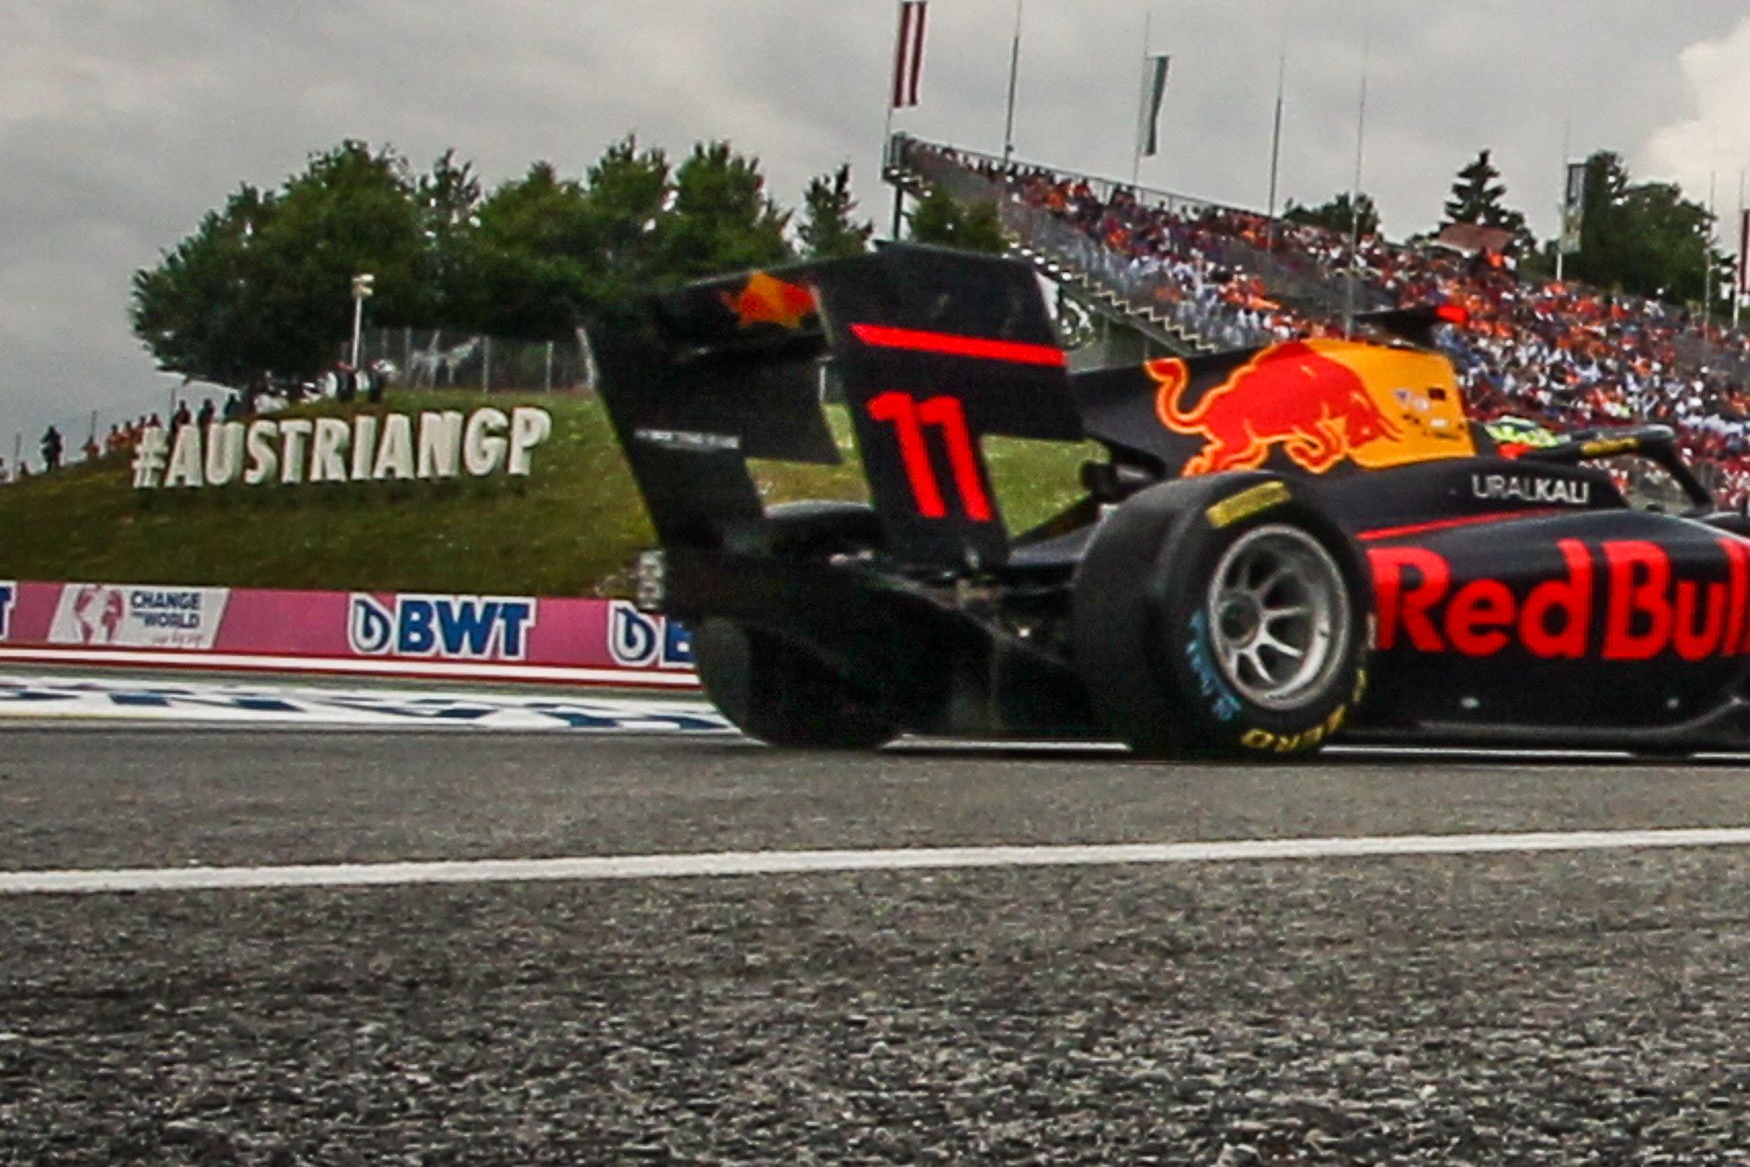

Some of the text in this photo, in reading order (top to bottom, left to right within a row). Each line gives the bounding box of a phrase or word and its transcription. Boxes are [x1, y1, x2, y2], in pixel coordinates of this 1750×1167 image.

[132, 407, 552, 489] #AUSTRIANGP
[867, 391, 992, 522] 11
[1472, 474, 1589, 503] URALKALI
[131, 590, 201, 610] CHANGE
[144, 612, 200, 629] WORLD
[1366, 538, 1594, 657] Red
[397, 599, 531, 658] BWT
